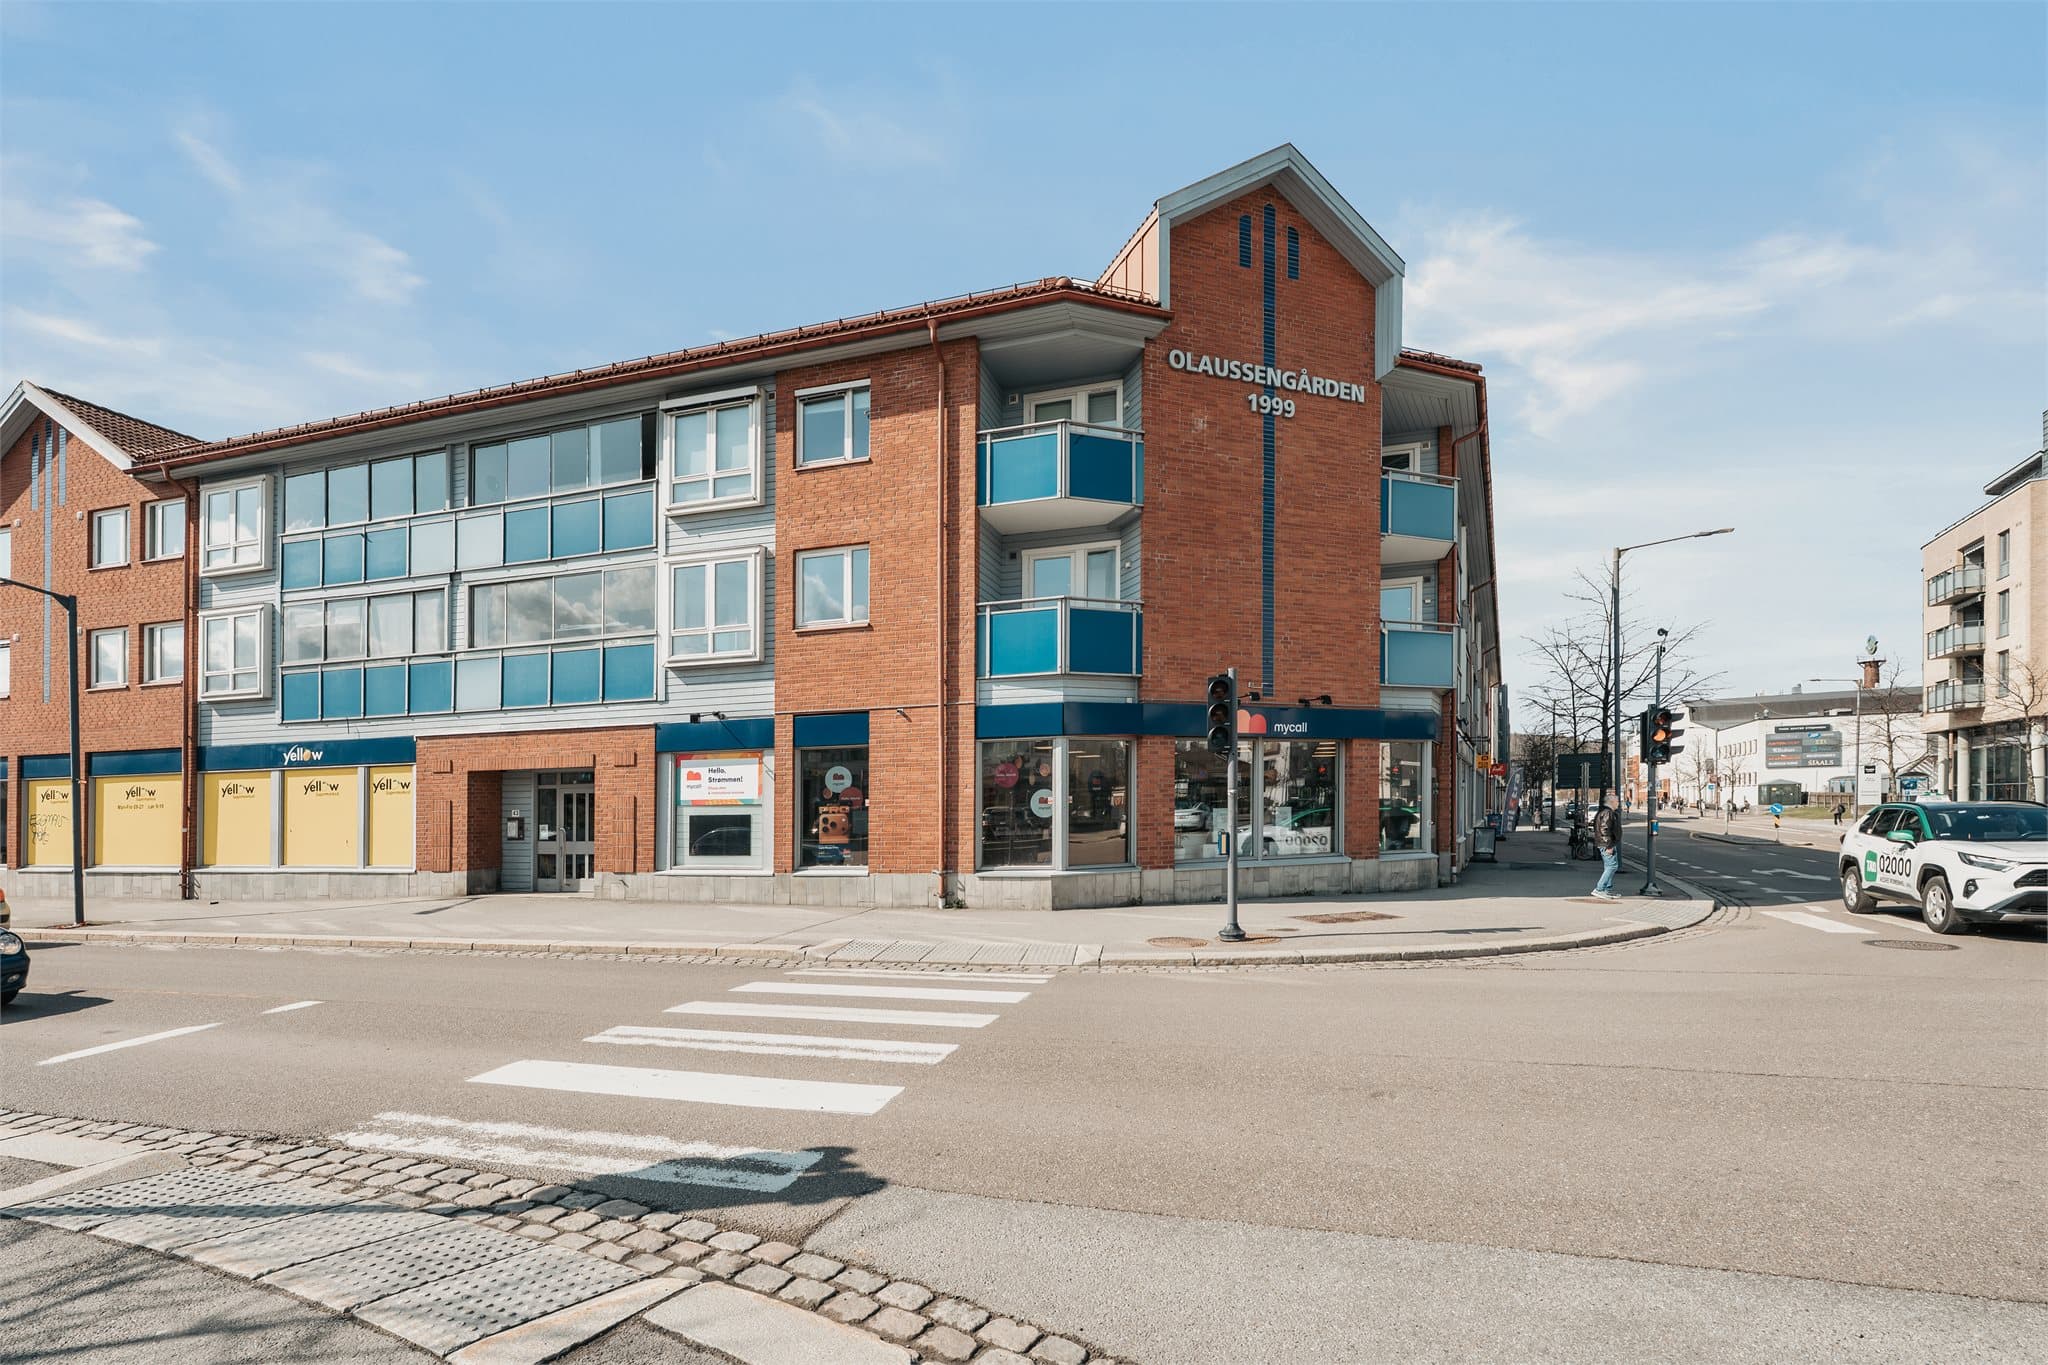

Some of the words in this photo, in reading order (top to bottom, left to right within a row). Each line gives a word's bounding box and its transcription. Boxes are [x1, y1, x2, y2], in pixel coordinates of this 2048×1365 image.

[1168, 349, 1366, 403] OLAUSSENGÅRDEN
[1248, 393, 1295, 418] 1999
[1273, 722, 1307, 735] mycall
[283, 744, 323, 766] yellow
[1880, 854, 1912, 877] 02000
